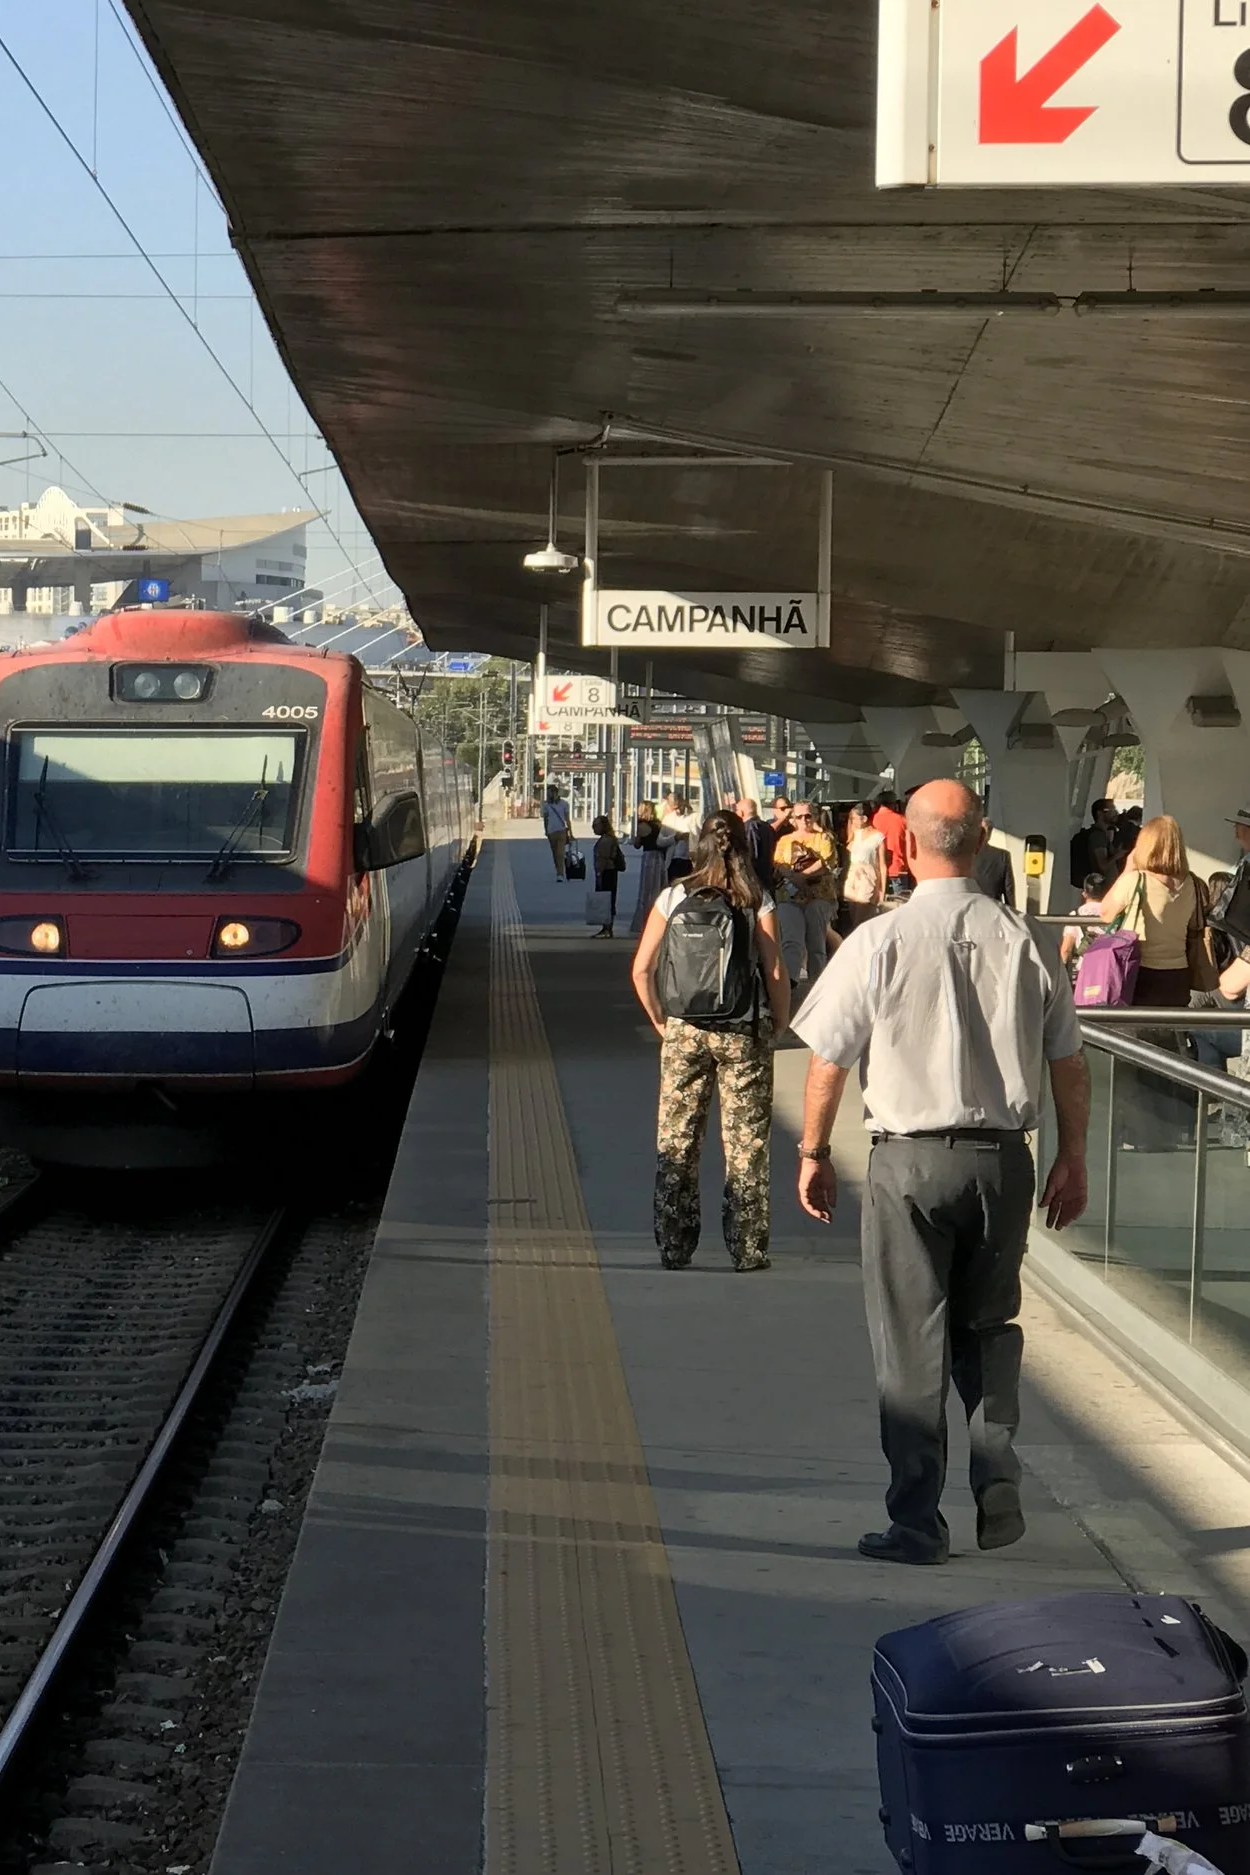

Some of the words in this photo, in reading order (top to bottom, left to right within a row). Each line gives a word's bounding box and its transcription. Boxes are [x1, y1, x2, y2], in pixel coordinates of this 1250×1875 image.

[607, 599, 808, 635] CAMPANHÃ
[587, 687, 600, 703] 8
[261, 706, 319, 719] 4005
[546, 701, 641, 718] CAMPANHÃ
[944, 1822, 1016, 1842] VERAGE
